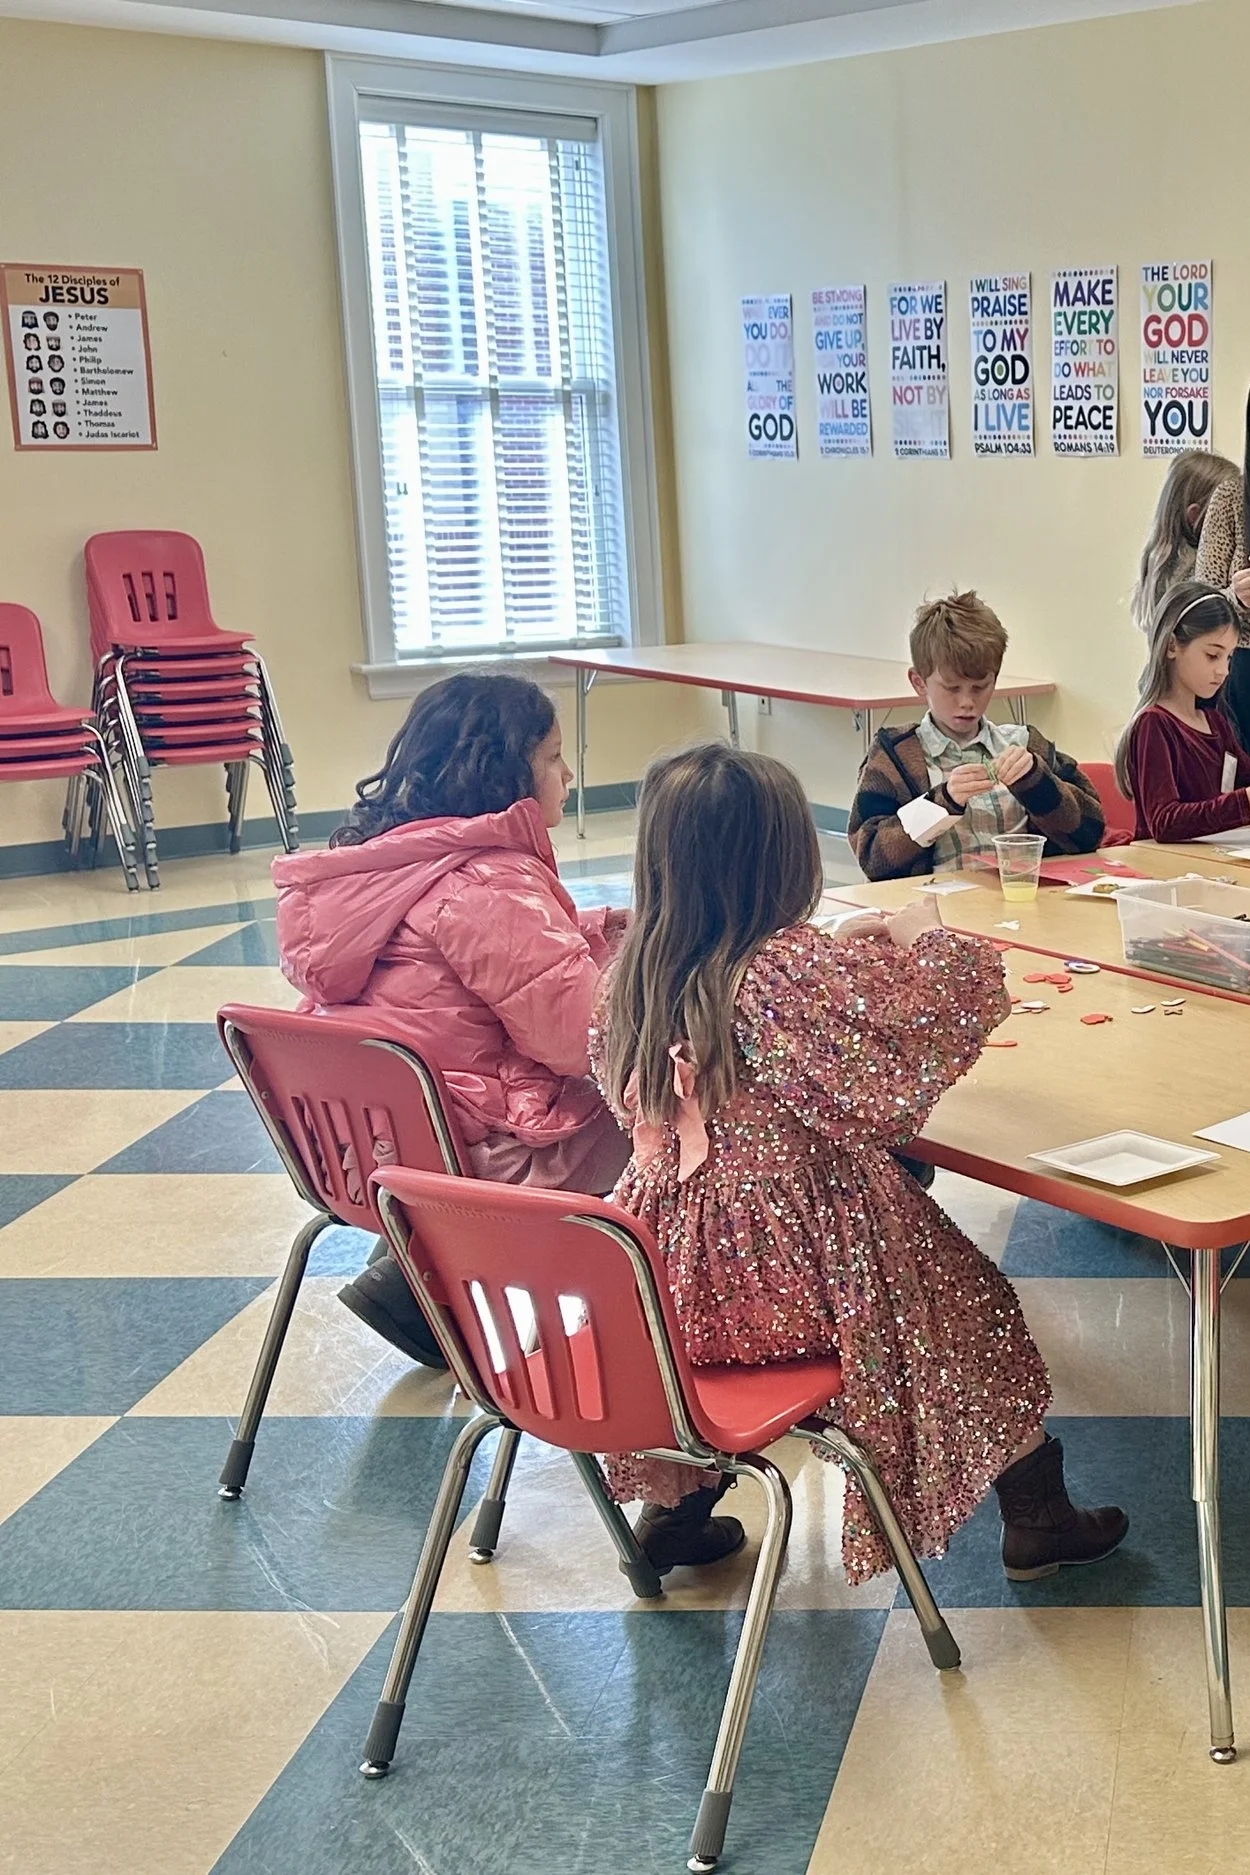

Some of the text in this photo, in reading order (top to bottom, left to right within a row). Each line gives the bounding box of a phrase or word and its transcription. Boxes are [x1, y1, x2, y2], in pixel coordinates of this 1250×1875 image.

[25, 273, 120, 287] The 12 Disciples of
[1142, 264, 1208, 282] THE LORD
[970, 276, 1027, 292] I WILL SING
[39, 285, 109, 304] JESUS
[812, 289, 863, 304] BE STRONG
[1053, 279, 1114, 308] MAKE
[1142, 282, 1209, 313] YOUR
[768, 306, 789, 319] EVER
[890, 295, 944, 315] FOR WE
[971, 294, 1028, 318] PRAISE
[75, 313, 97, 321] Peter
[833, 313, 864, 325] DO NOT
[1054, 310, 1115, 336] EVERY
[76, 324, 108, 332] Andrew
[744, 324, 767, 340] YOU
[891, 317, 944, 341] LIVE BY
[1143, 313, 1209, 348] GOD
[77, 335, 102, 343] James
[815, 330, 865, 351] GIVE UP,
[973, 328, 1029, 353] TO MY
[78, 345, 98, 353] John
[1054, 339, 1115, 357] EFFORT TO
[79, 356, 102, 365] Philip
[837, 353, 866, 367] YOUR
[892, 345, 946, 372] FAITH,
[1144, 350, 1209, 365] WILL NEVER
[80, 367, 134, 375] Bartholomew
[974, 354, 1030, 386] GOD
[1054, 362, 1115, 379] DO WHAT
[1143, 368, 1209, 383] LEAVE YOU
[777, 380, 792, 392] THE
[818, 371, 867, 394] WORK
[81, 388, 118, 396] Matthew
[893, 385, 946, 405] NOT BY
[974, 387, 1031, 401] AS LONG AS
[1053, 383, 1115, 401] LEADS TO
[1143, 387, 1209, 398] NOR FORSAKE
[82, 399, 108, 407] James
[747, 396, 793, 411] GLORY OF
[852, 399, 867, 418] BE
[83, 409, 122, 417] Thaddeus
[974, 403, 1030, 432] I LIVE
[1052, 405, 1114, 431] PEACE
[1143, 400, 1209, 437] YOU
[84, 420, 115, 428] Thomas
[749, 413, 794, 441] GOD
[819, 422, 868, 436] REWARDED
[85, 430, 108, 438] Judas
[975, 443, 1032, 454] PSALM 104:33
[1053, 442, 1115, 453] ROMANS 14:19
